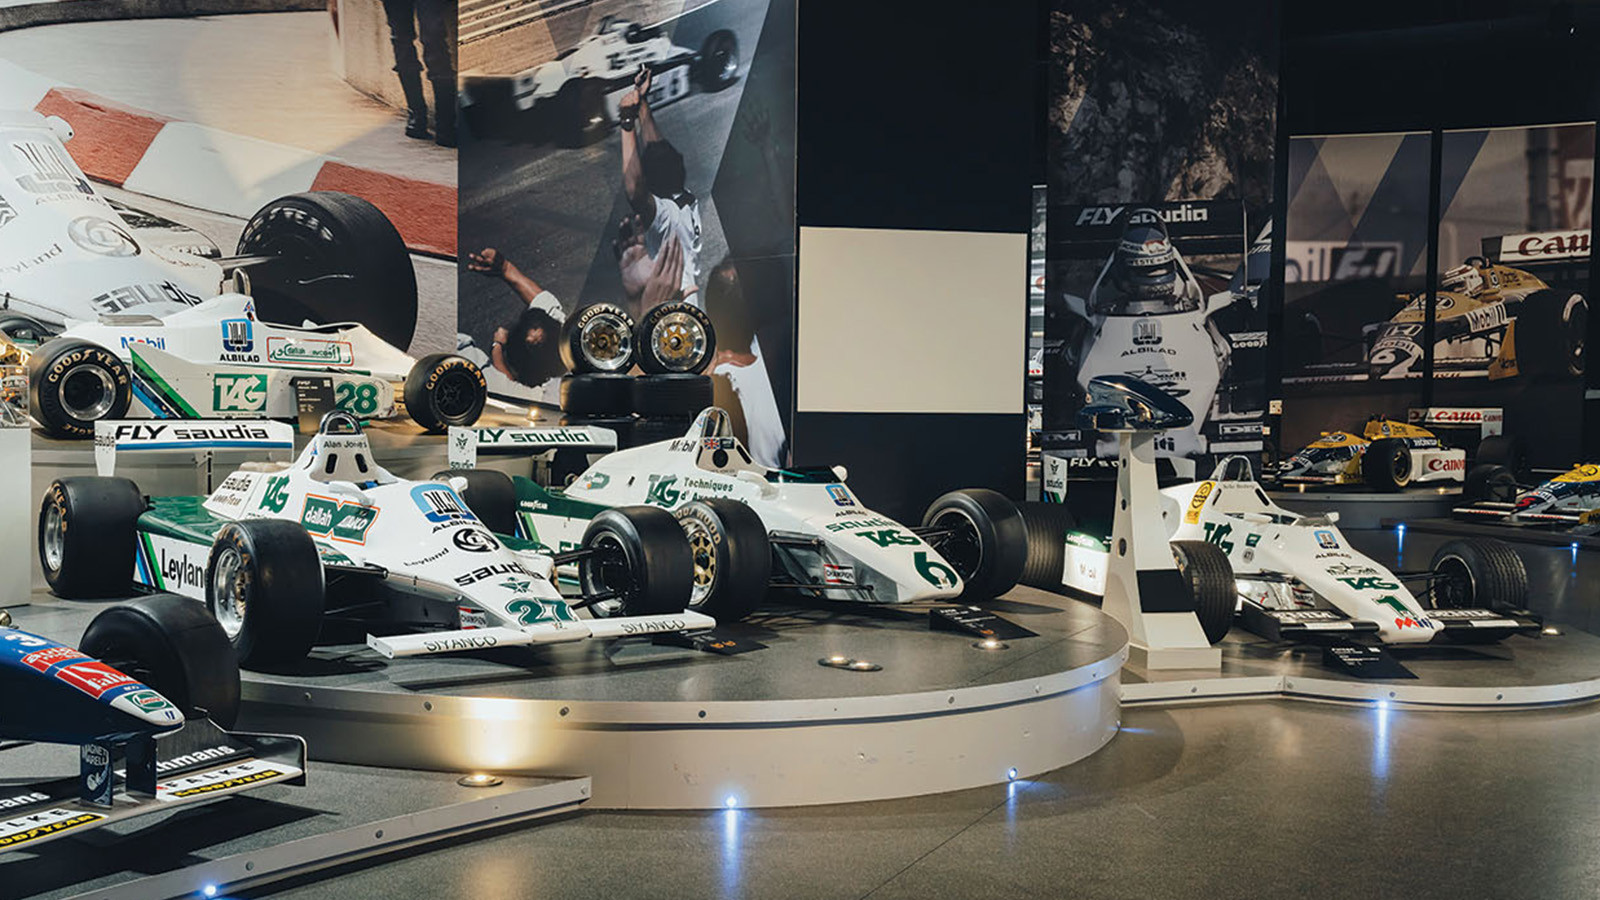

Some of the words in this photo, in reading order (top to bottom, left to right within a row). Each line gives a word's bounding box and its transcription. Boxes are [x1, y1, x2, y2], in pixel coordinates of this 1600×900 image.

[1075, 207, 1124, 226] FLY
[219, 353, 261, 364] ALBILAD
[1120, 345, 1177, 357] ALBILAD
[215, 374, 267, 411] TAG
[336, 380, 379, 415] 28
[1435, 411, 1483, 421] Cano
[115, 425, 168, 440] FLY
[174, 424, 270, 440] saudia
[510, 428, 591, 443] saudia
[323, 440, 342, 448] Alan
[344, 440, 368, 449] Jones
[1071, 457, 1097, 467] FLY
[644, 474, 681, 508] TAG
[684, 477, 734, 492] Techniques
[259, 474, 291, 514] TAG
[403, 547, 450, 567] Leyland
[453, 561, 547, 588] saudia
[913, 551, 957, 590] 6
[504, 596, 579, 627] 27
[624, 618, 686, 634] SIYANCO
[425, 634, 498, 652] SIYANCO
[168, 763, 255, 789] FALKE
